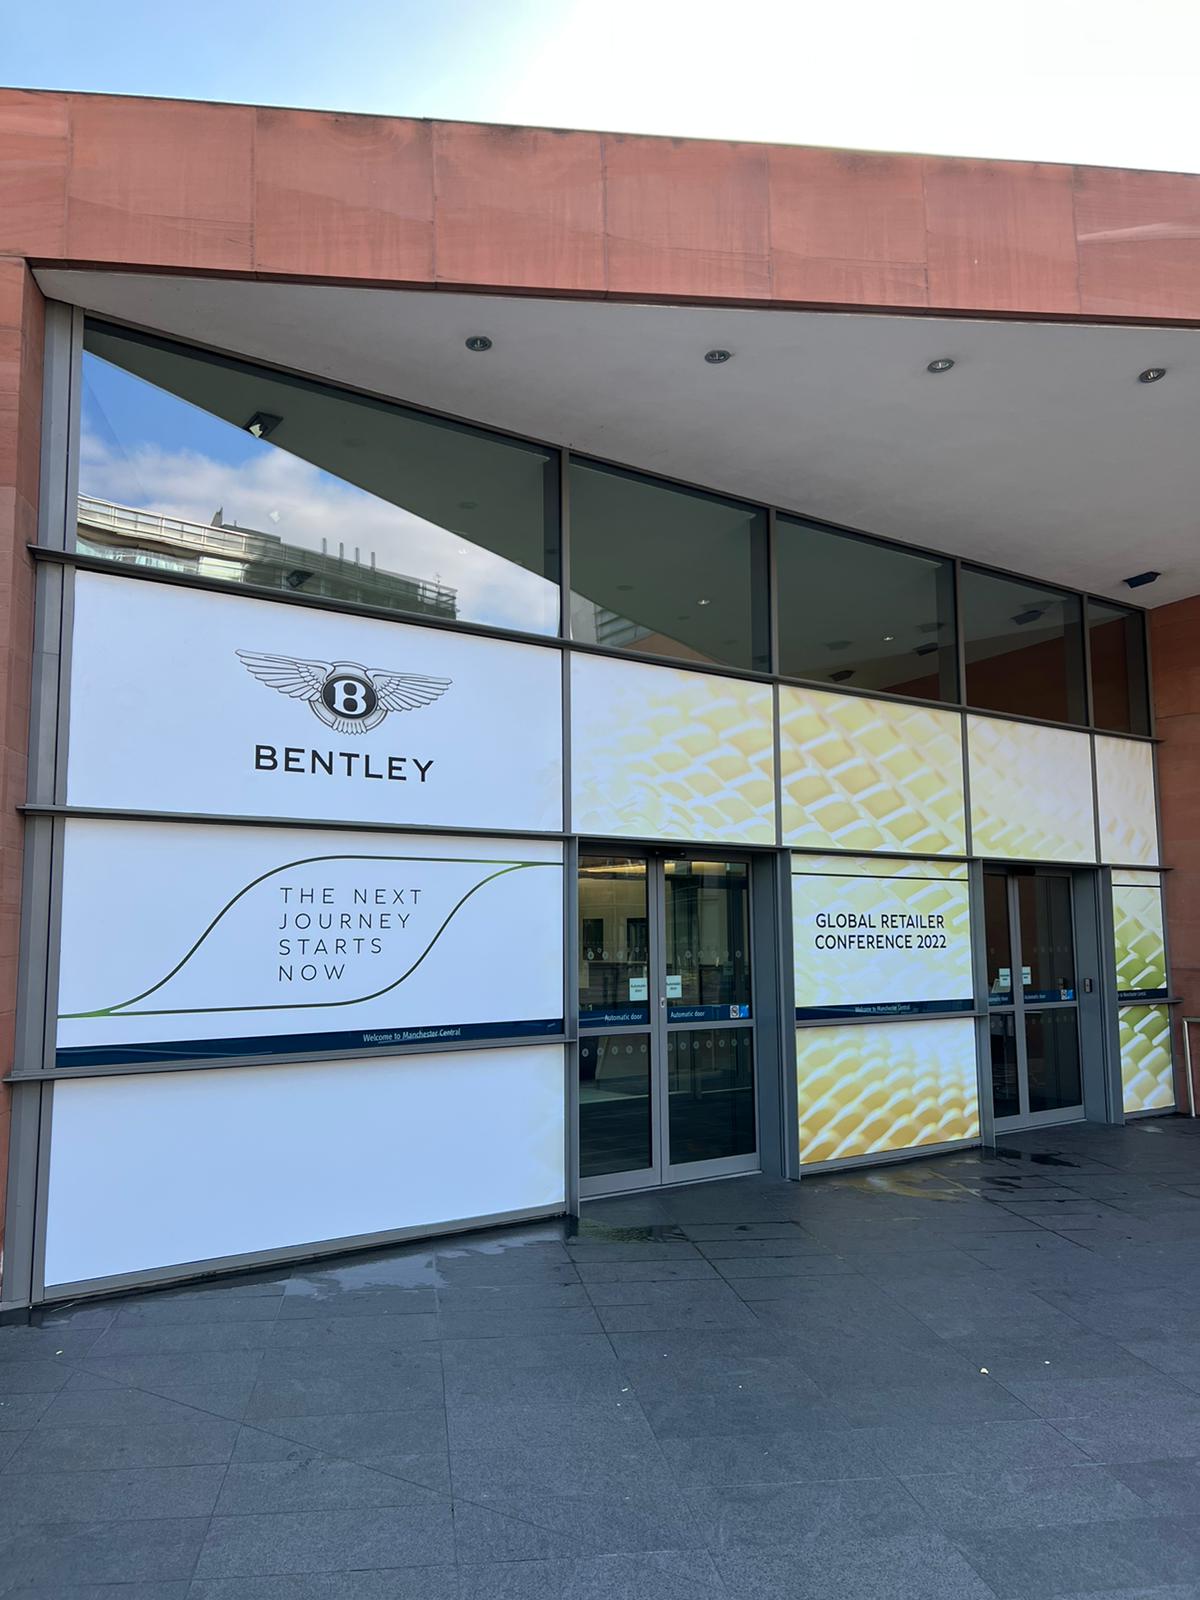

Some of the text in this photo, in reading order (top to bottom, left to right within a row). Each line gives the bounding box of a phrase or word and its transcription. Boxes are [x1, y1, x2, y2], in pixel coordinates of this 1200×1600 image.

[333, 679, 367, 715] B
[255, 744, 435, 782] BENTLEY
[280, 887, 421, 904] THE NEXT
[279, 913, 410, 929] JOURNEY
[815, 913, 944, 929] GLOBAL RETAILER
[279, 938, 382, 955] STARTS
[815, 934, 947, 949] CONFERENCE 2022
[279, 964, 345, 981] NOW
[604, 1012, 643, 1021] Automatic door
[363, 1033, 393, 1042] Welcome
[402, 1030, 438, 1040] Manchester
[440, 1028, 461, 1037] Central
